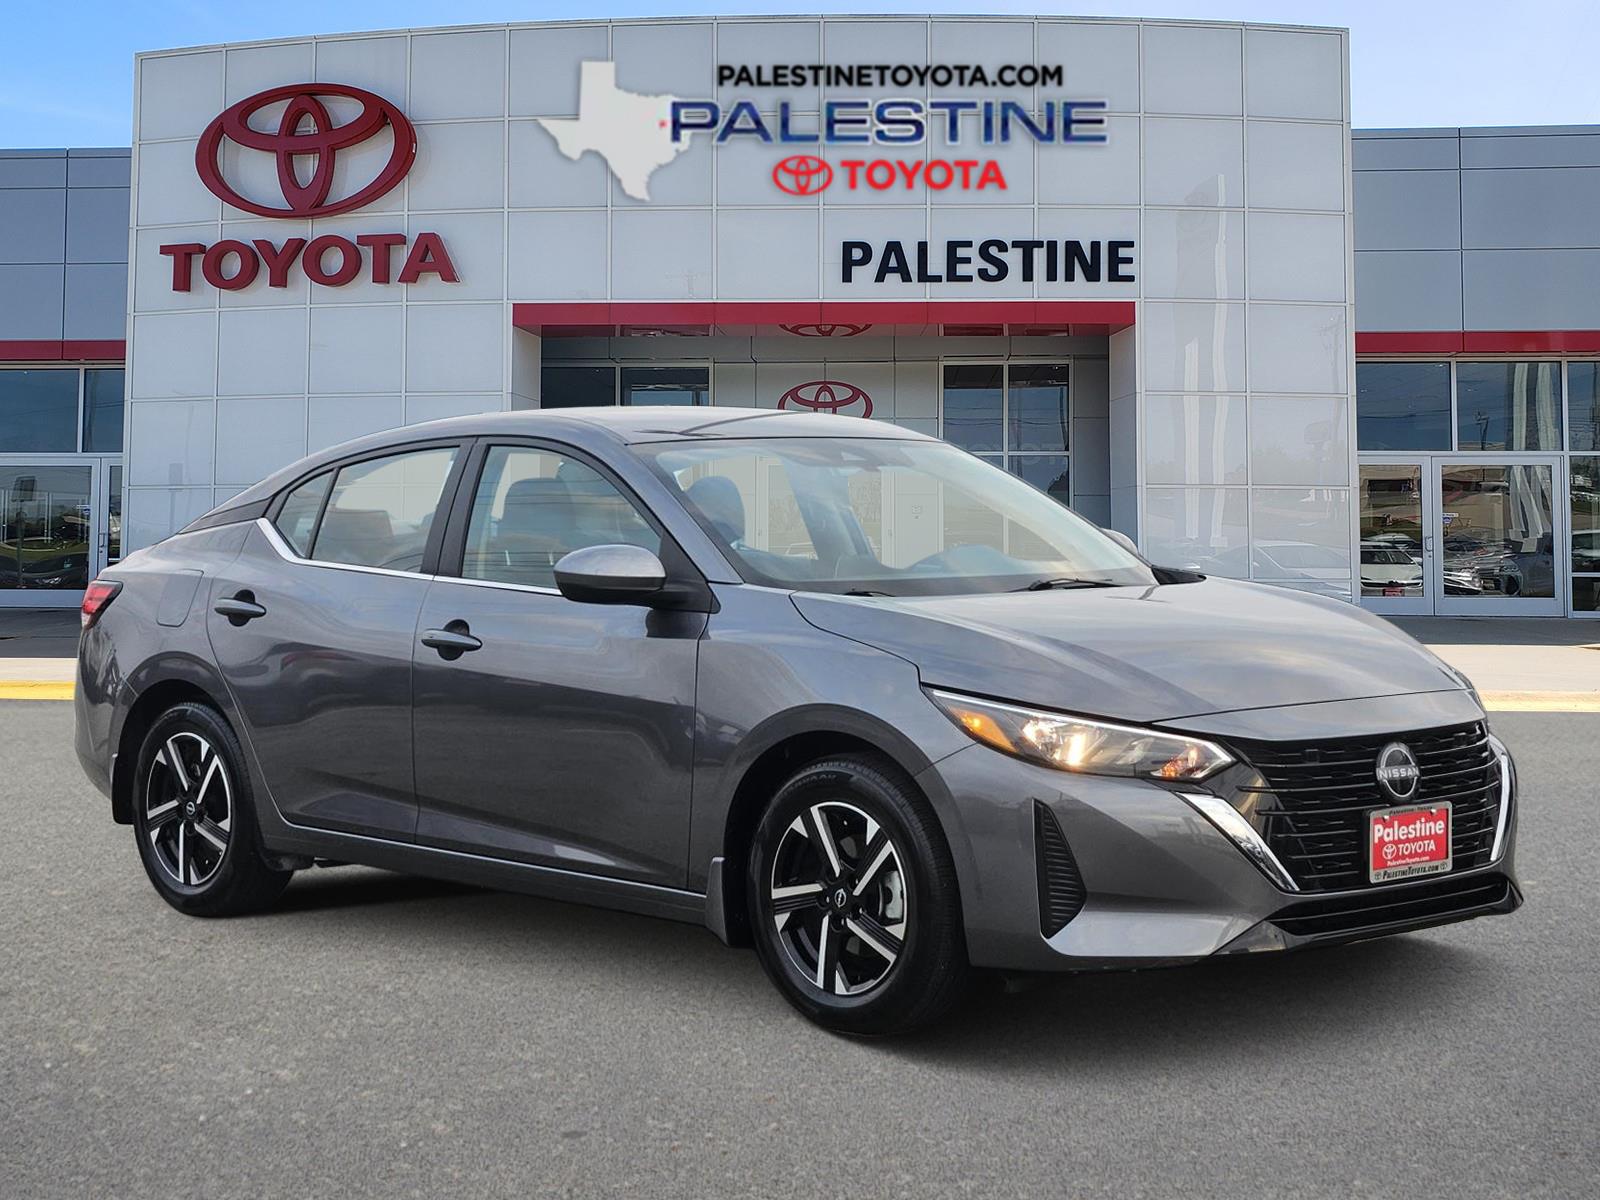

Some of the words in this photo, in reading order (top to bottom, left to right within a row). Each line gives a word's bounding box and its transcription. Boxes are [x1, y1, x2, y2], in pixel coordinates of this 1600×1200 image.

[159, 232, 461, 293] TOYOTA
[841, 240, 1136, 283] PALESTINE
[1379, 767, 1420, 778] NISSAN
[1374, 819, 1445, 843] Palestine
[1398, 840, 1436, 856] TOYOTA
